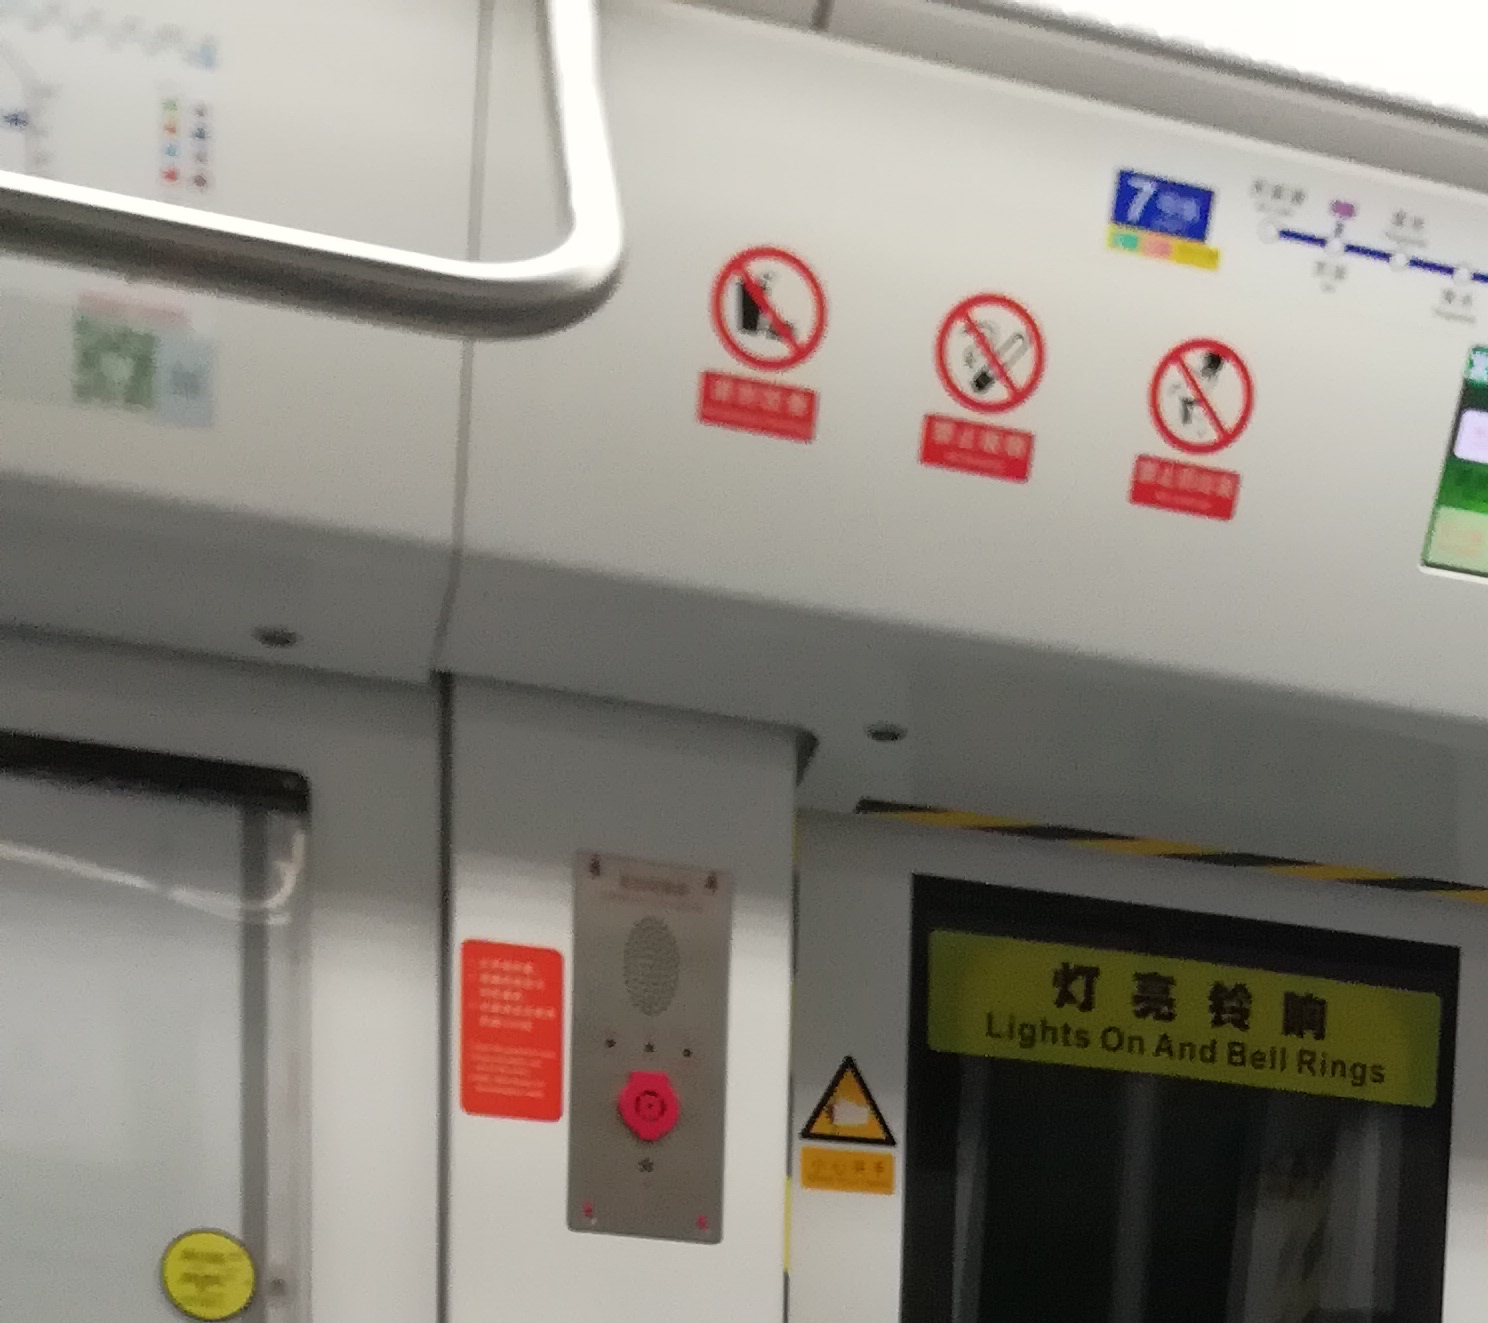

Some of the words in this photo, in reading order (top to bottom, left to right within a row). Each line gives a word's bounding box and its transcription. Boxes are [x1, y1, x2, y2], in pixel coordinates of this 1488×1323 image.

[1052, 961, 1328, 1041] 灯亮铃响
[985, 1012, 1091, 1049] Lights
[1100, 1026, 1145, 1056] On
[1154, 1032, 1218, 1064] And
[1227, 1041, 1287, 1072] Bell
[1297, 1048, 1386, 1087] Rings
